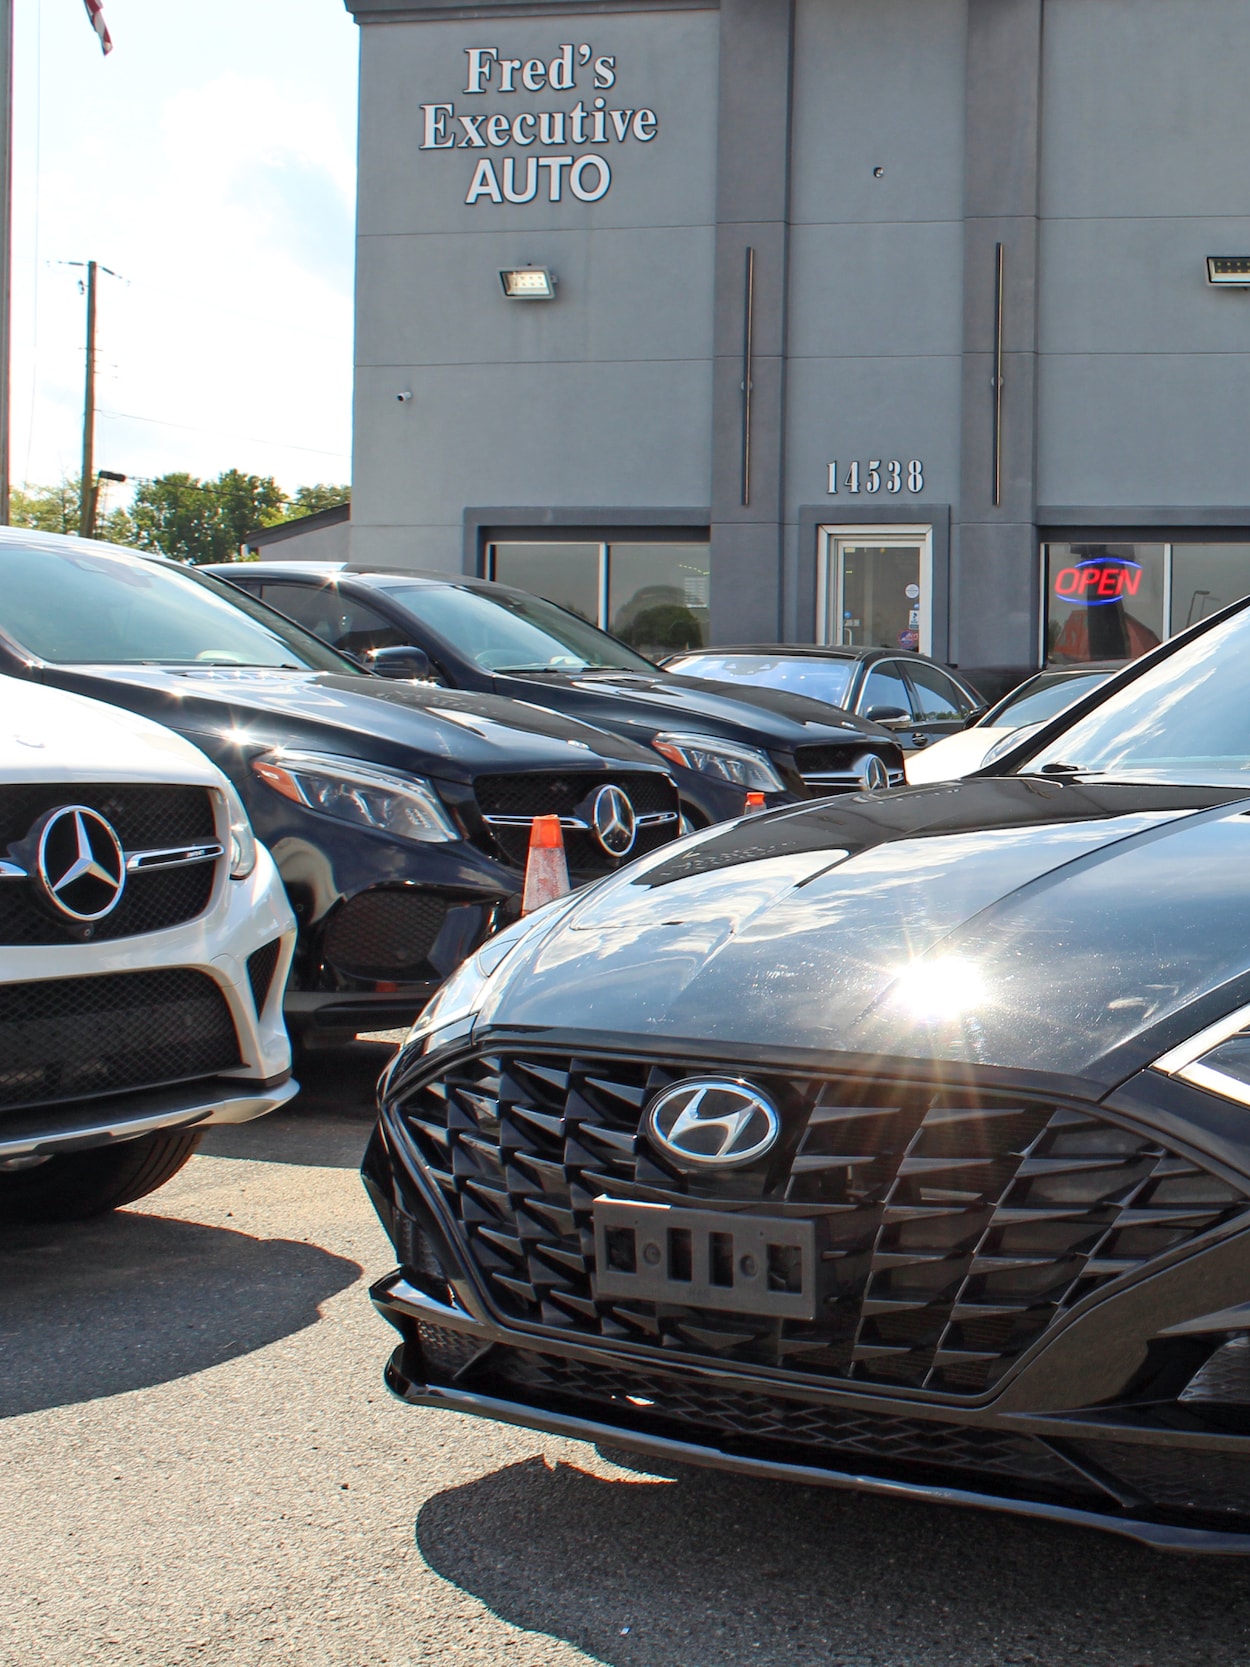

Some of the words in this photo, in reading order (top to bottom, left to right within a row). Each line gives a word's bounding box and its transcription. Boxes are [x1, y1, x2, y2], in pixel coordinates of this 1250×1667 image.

[463, 43, 617, 94] Fred's
[419, 98, 659, 150] Executive
[465, 153, 612, 205] AUTO
[825, 459, 925, 494] 14538
[1055, 568, 1143, 596] OPEN
